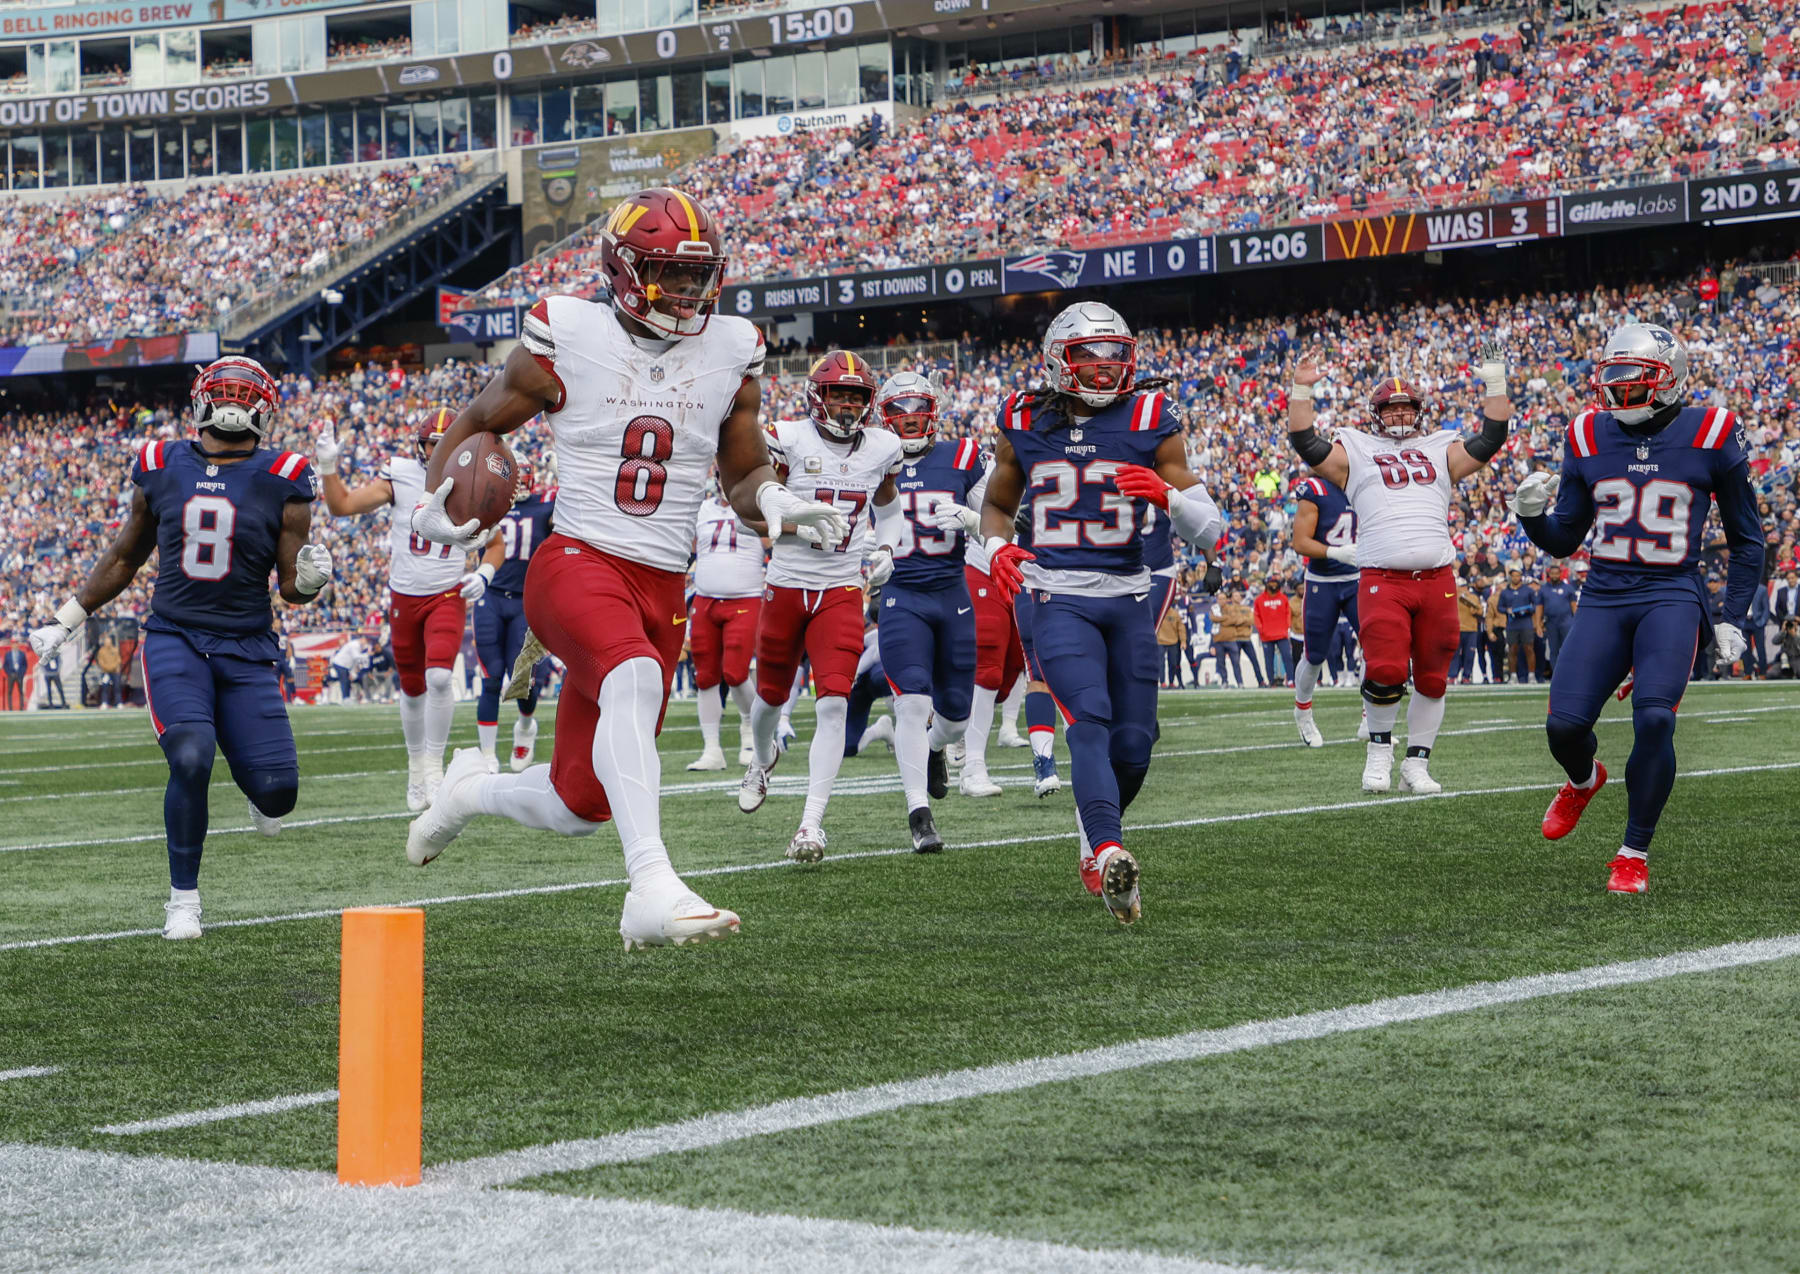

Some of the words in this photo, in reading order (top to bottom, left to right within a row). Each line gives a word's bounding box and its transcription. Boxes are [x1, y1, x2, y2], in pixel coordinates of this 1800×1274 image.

[3, 17, 48, 33] BELL
[53, 9, 134, 29] RINGING
[140, 5, 192, 22] BREW
[712, 25, 732, 35] QTR
[768, 6, 854, 45] 15:00
[656, 30, 676, 58] 0
[719, 36, 730, 50] 2
[492, 52, 512, 79] 0
[1, 100, 50, 125] OUT
[55, 98, 89, 121] OF
[92, 92, 168, 118] TOWN
[174, 82, 270, 112] SCORES
[794, 114, 847, 128] Putnam
[609, 154, 663, 172] Walmart
[1700, 183, 1758, 212] 2ND
[1764, 179, 1780, 206] &
[1786, 177, 1800, 202] 7
[1511, 207, 1529, 234] 3
[1569, 194, 1677, 224] GilletteLabs
[1426, 211, 1484, 244] WAS
[1167, 246, 1186, 272] 0
[1229, 231, 1308, 265] 12:06
[1103, 250, 1136, 278] NE
[838, 279, 855, 304] 3
[860, 280, 882, 298] 1ST
[883, 275, 927, 296] DOWNS
[945, 268, 965, 293] 0
[970, 269, 998, 287] PEN.
[736, 289, 753, 314] 8
[764, 289, 796, 308] RUSH
[797, 286, 820, 304] YDS
[485, 312, 514, 336] NE
[606, 396, 705, 410] WASHINGTON
[1065, 445, 1097, 455] PATRIOTS
[614, 414, 674, 517] 8
[1627, 464, 1659, 473] PATRIOTS
[195, 481, 226, 491] PATRIOTS
[816, 480, 871, 489] WASHINGTON
[1030, 459, 1137, 547] 23
[705, 518, 737, 553] 71
[1325, 511, 1359, 547] 4
[1591, 477, 1694, 566] 29
[181, 494, 237, 583] 8
